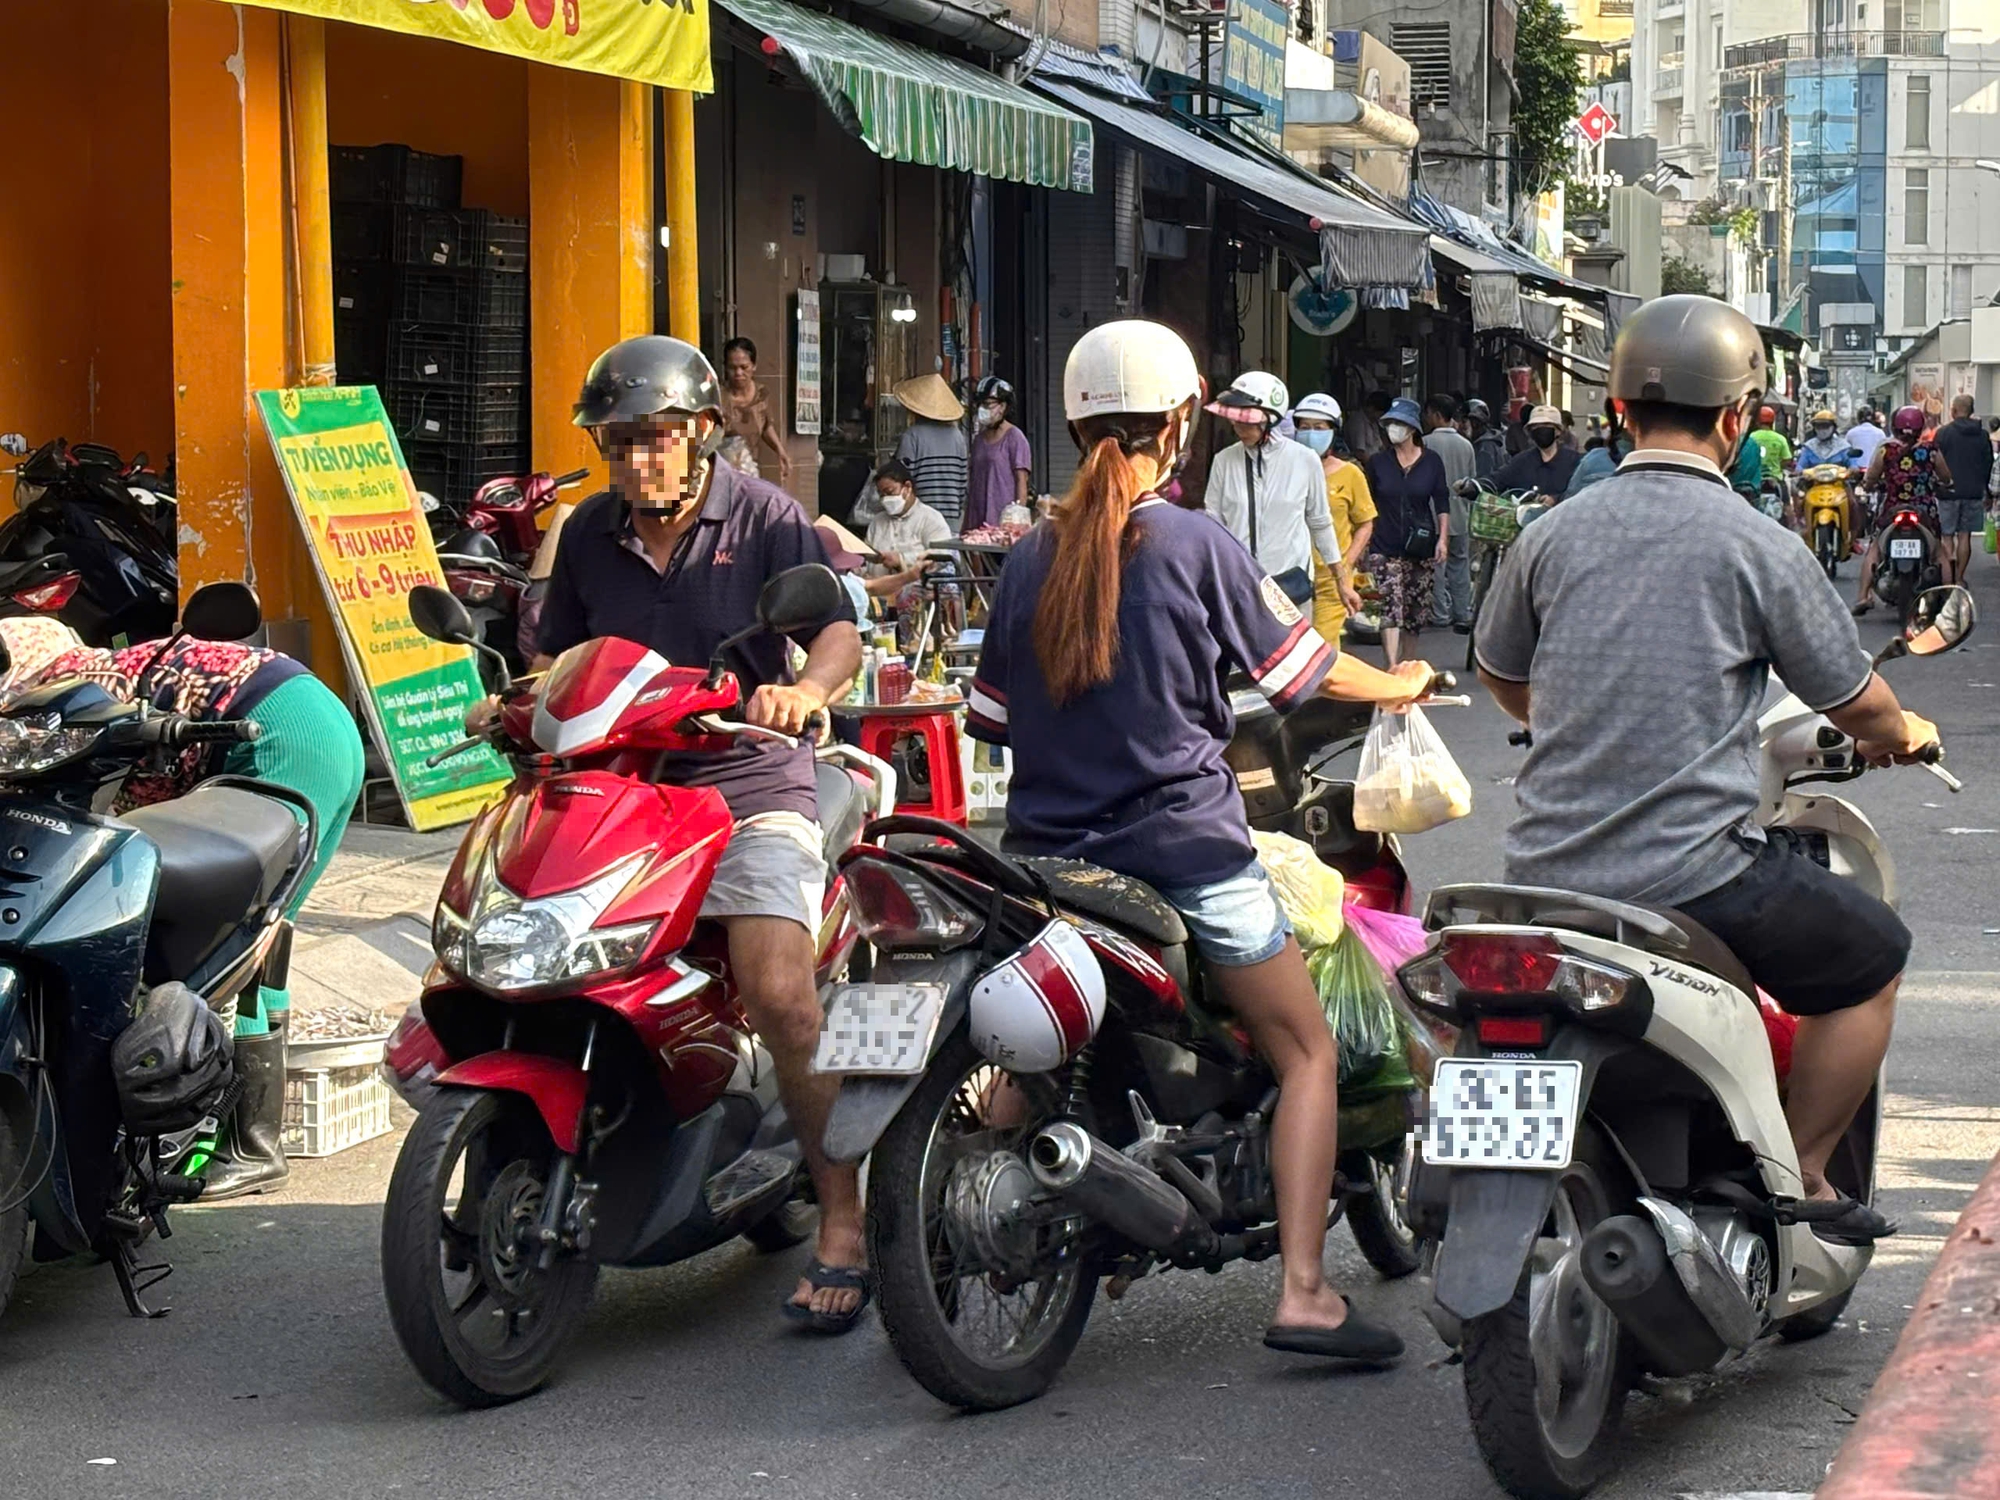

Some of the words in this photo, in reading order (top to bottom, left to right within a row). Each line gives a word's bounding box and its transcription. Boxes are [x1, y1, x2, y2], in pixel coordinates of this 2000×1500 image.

[286, 436, 341, 474] TUYỂN
[340, 441, 392, 475] DỤNG
[329, 530, 367, 558] THU
[367, 519, 417, 559] NHẬP
[356, 565, 371, 599] 6
[378, 563, 396, 595] 9
[6, 808, 73, 836] HONDA
[892, 952, 935, 961] HONDA
[1649, 960, 1720, 997] VISION
[659, 1005, 699, 1030] HONDA
[1491, 1052, 1537, 1060] HONDA
